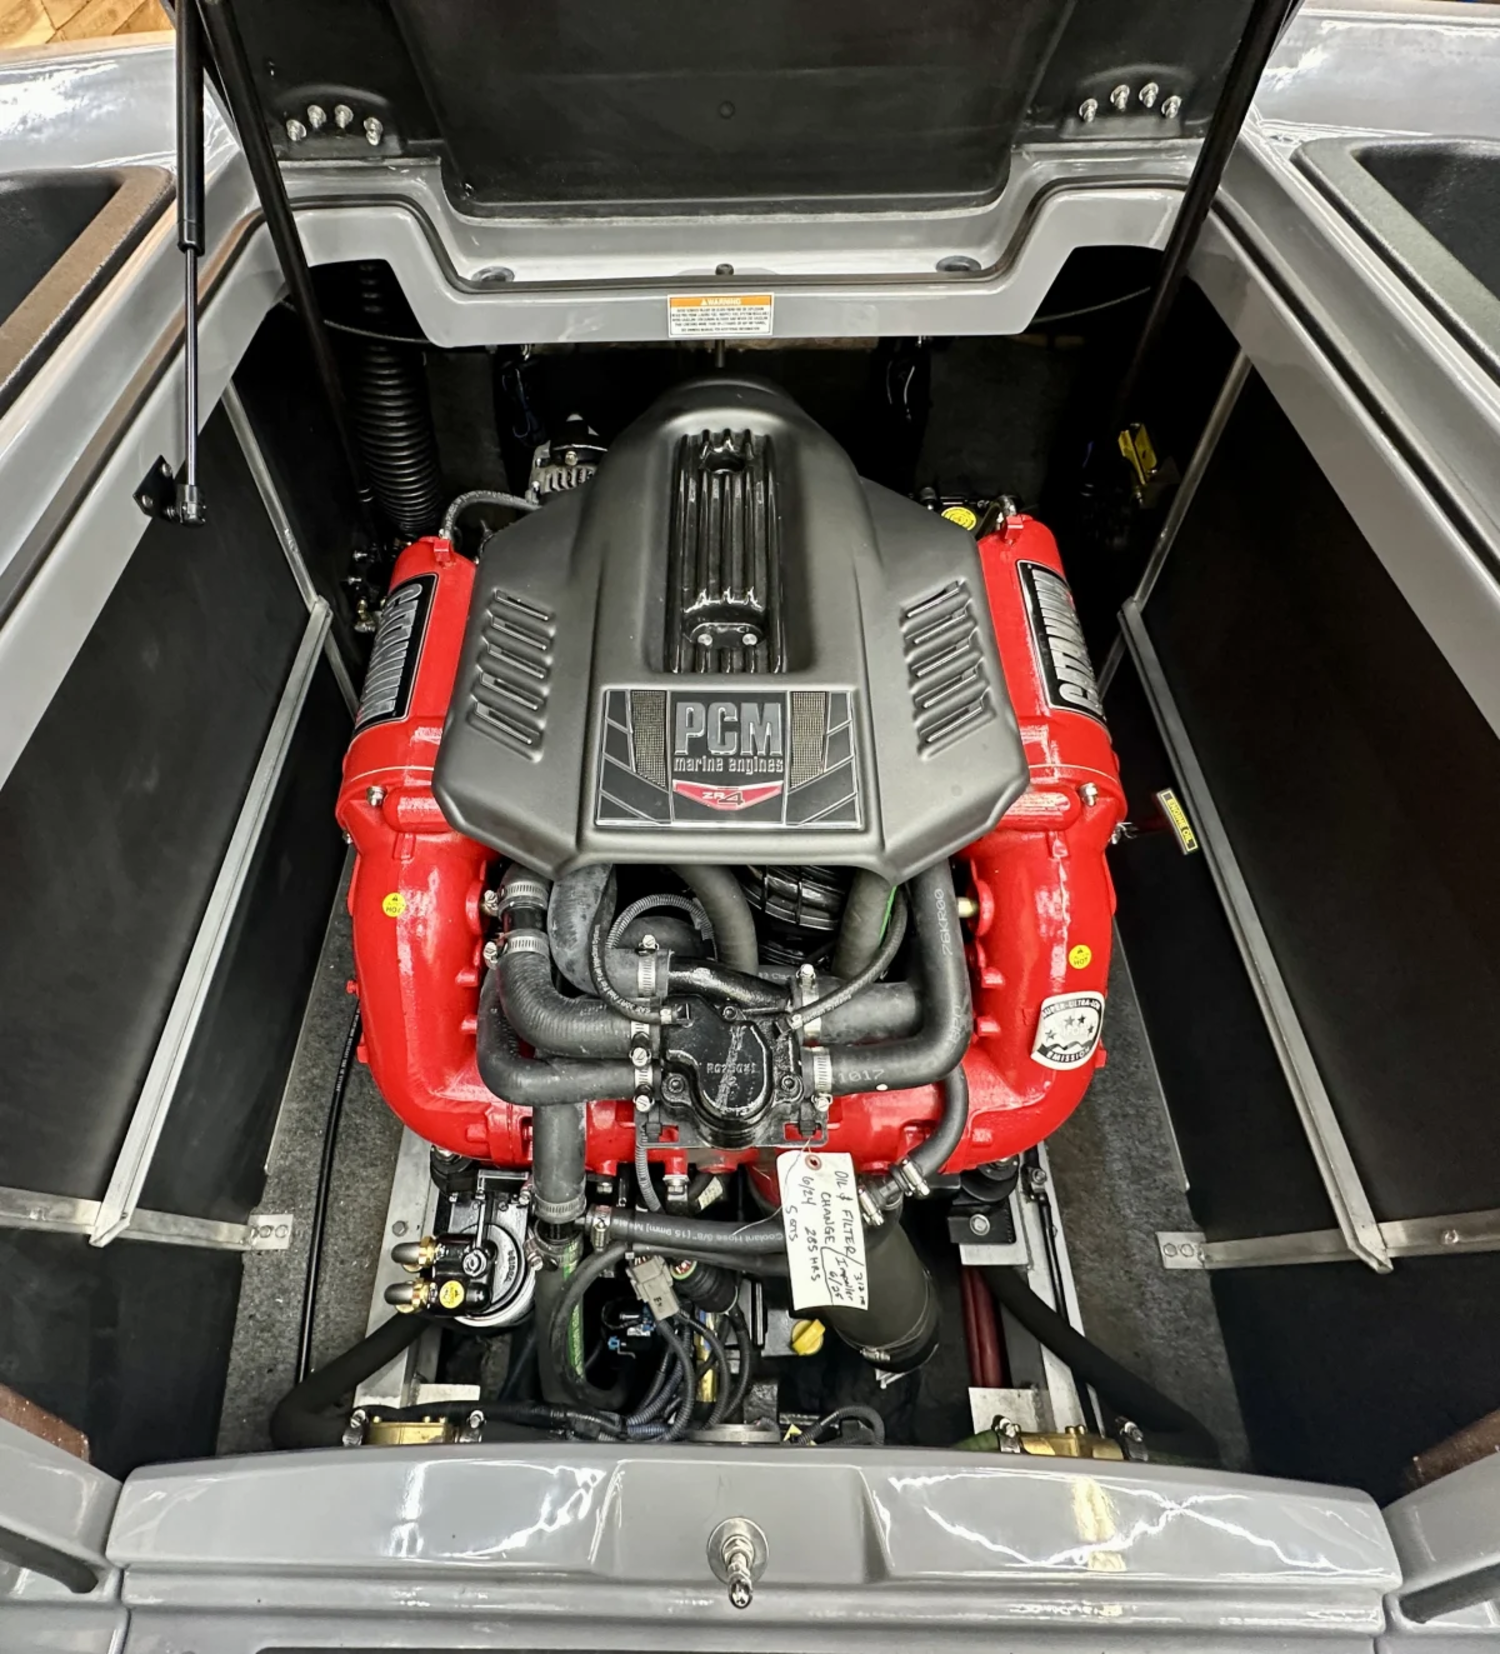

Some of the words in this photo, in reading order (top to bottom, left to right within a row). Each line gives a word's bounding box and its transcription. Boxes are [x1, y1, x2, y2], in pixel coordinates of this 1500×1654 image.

[675, 702, 783, 756] PCM
[674, 757, 724, 772] marine
[728, 757, 784, 775] engines
[702, 791, 744, 806] ZR4
[798, 1176, 817, 1206] 6/24
[810, 1256, 821, 1282] HRS
[820, 1191, 836, 1244] CHANGE
[834, 1170, 849, 1189] OIL
[842, 1209, 856, 1257] FILTER
